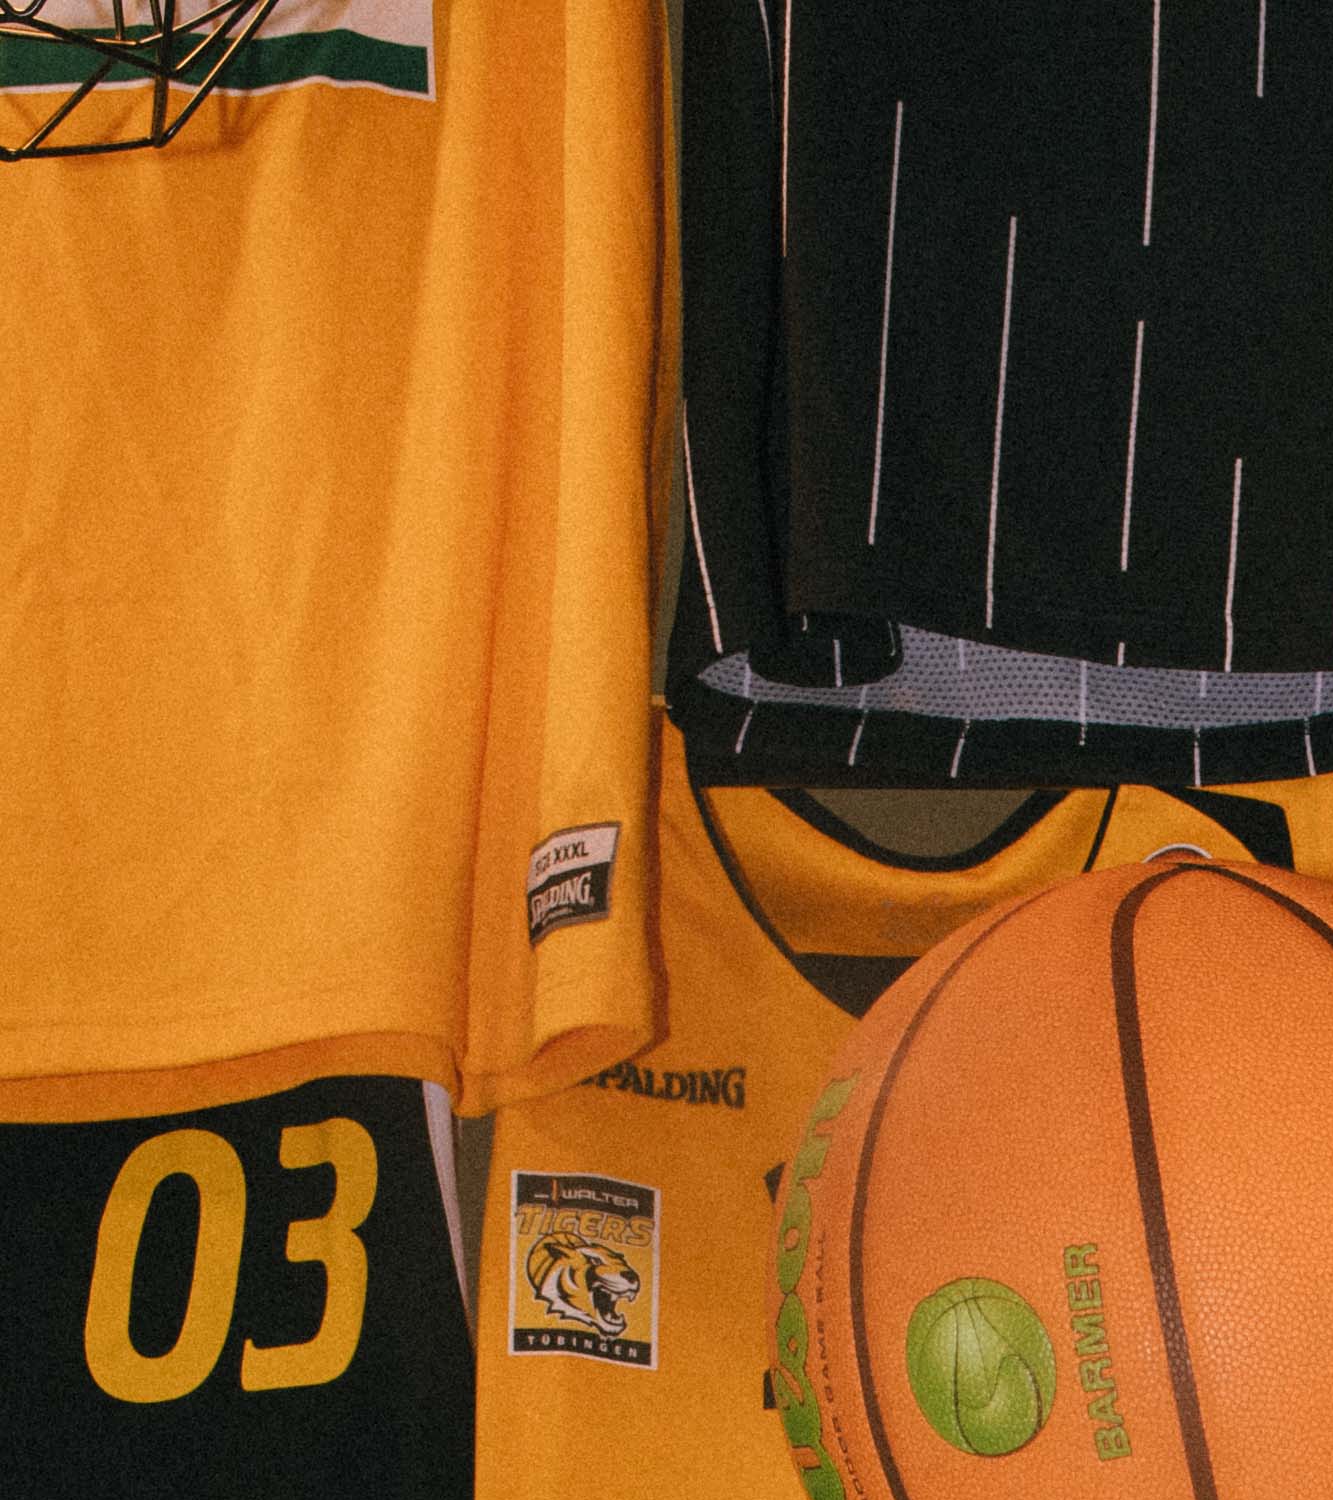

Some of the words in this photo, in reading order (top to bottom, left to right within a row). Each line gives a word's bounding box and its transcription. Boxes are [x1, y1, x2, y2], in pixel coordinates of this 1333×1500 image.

[554, 841, 589, 864] XXXL
[561, 1188, 639, 1209] WALTER
[516, 1203, 655, 1247] TIGERS
[84, 1117, 379, 1404] 03
[528, 1335, 638, 1358] TÜBINGEN
[1062, 1242, 1133, 1461] BARMER
